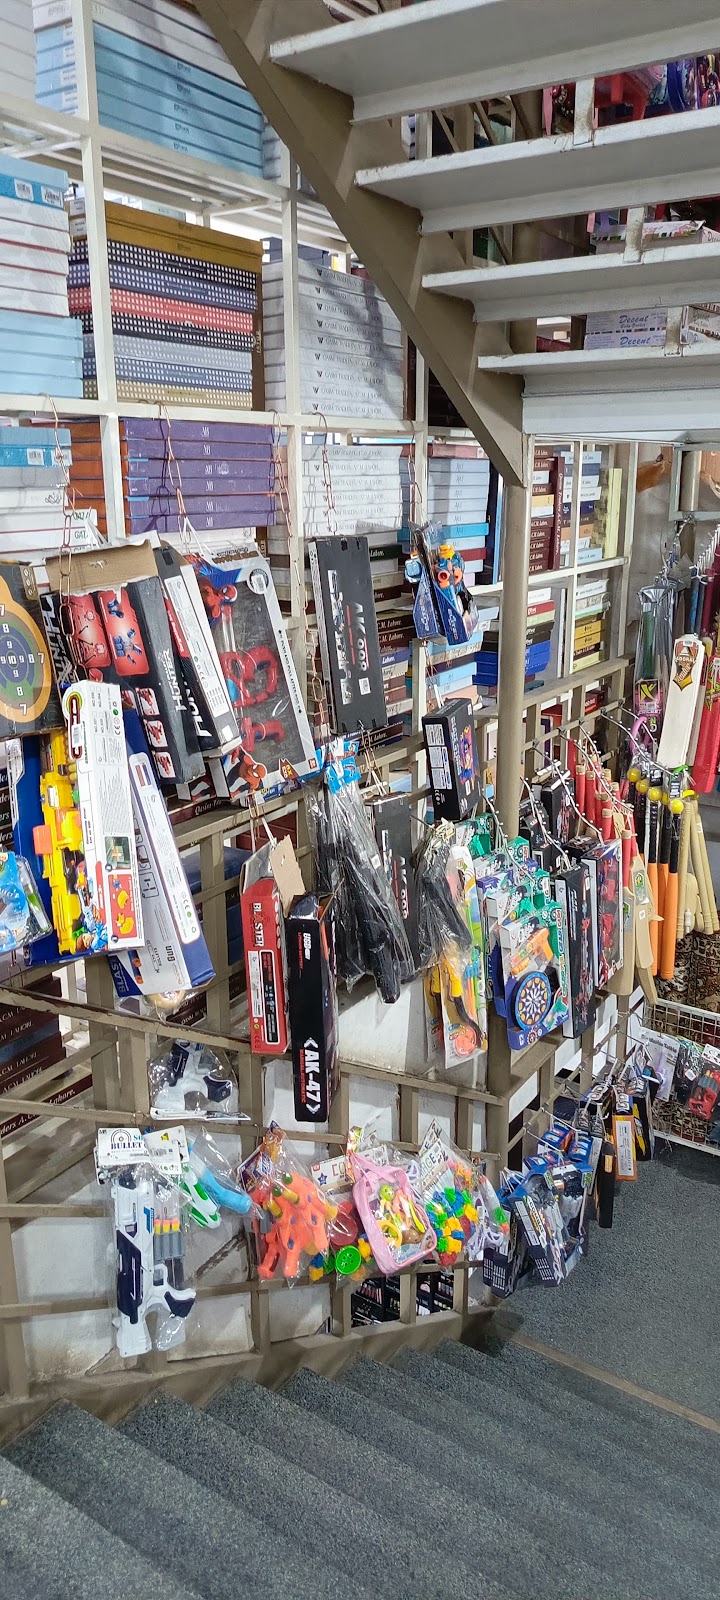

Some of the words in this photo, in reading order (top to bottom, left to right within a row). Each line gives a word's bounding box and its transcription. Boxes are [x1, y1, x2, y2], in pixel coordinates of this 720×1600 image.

[619, 315, 649, 324] Decent
[620, 336, 650, 346] Decent
[353, 601, 366, 635] AK
[2, 624, 9, 633] 8
[7, 641, 12, 649] 9
[8, 655, 17, 665] 10
[19, 655, 24, 663] 9
[28, 654, 34, 664] 8
[38, 653, 44, 664] 7
[159, 649, 187, 712] HUNTER
[17, 687, 23, 696] 8
[20, 704, 27, 715] 7
[251, 902, 266, 947] BLASTER
